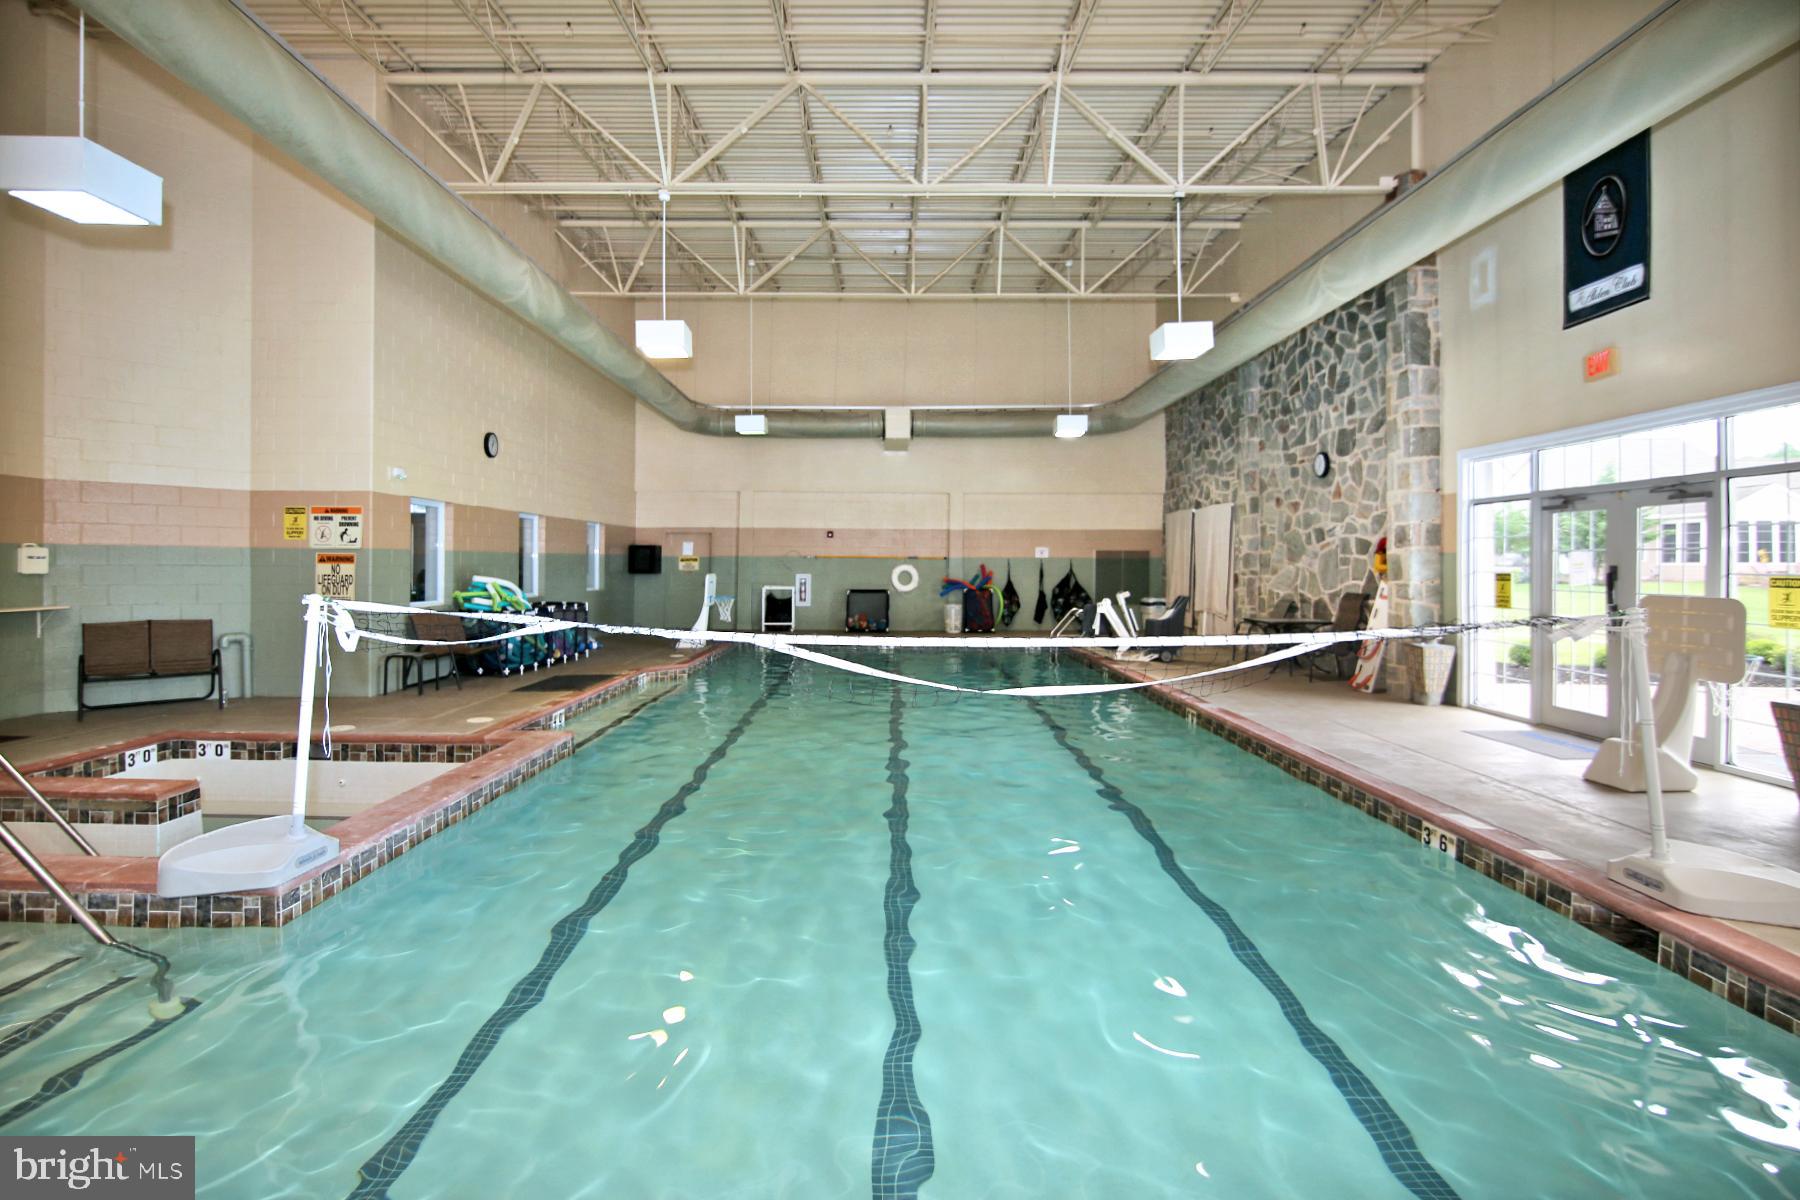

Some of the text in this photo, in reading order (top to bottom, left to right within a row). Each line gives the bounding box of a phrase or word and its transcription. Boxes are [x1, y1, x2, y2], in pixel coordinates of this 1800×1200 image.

[331, 564, 341, 574] NO
[317, 575, 354, 585] LIFEGUARD
[321, 585, 350, 596] ON DUTY
[198, 743, 206, 757] 3
[215, 743, 223, 757] 0
[127, 753, 135, 767] 3
[143, 749, 151, 763] 0
[1423, 826, 1447, 852] 3 6
